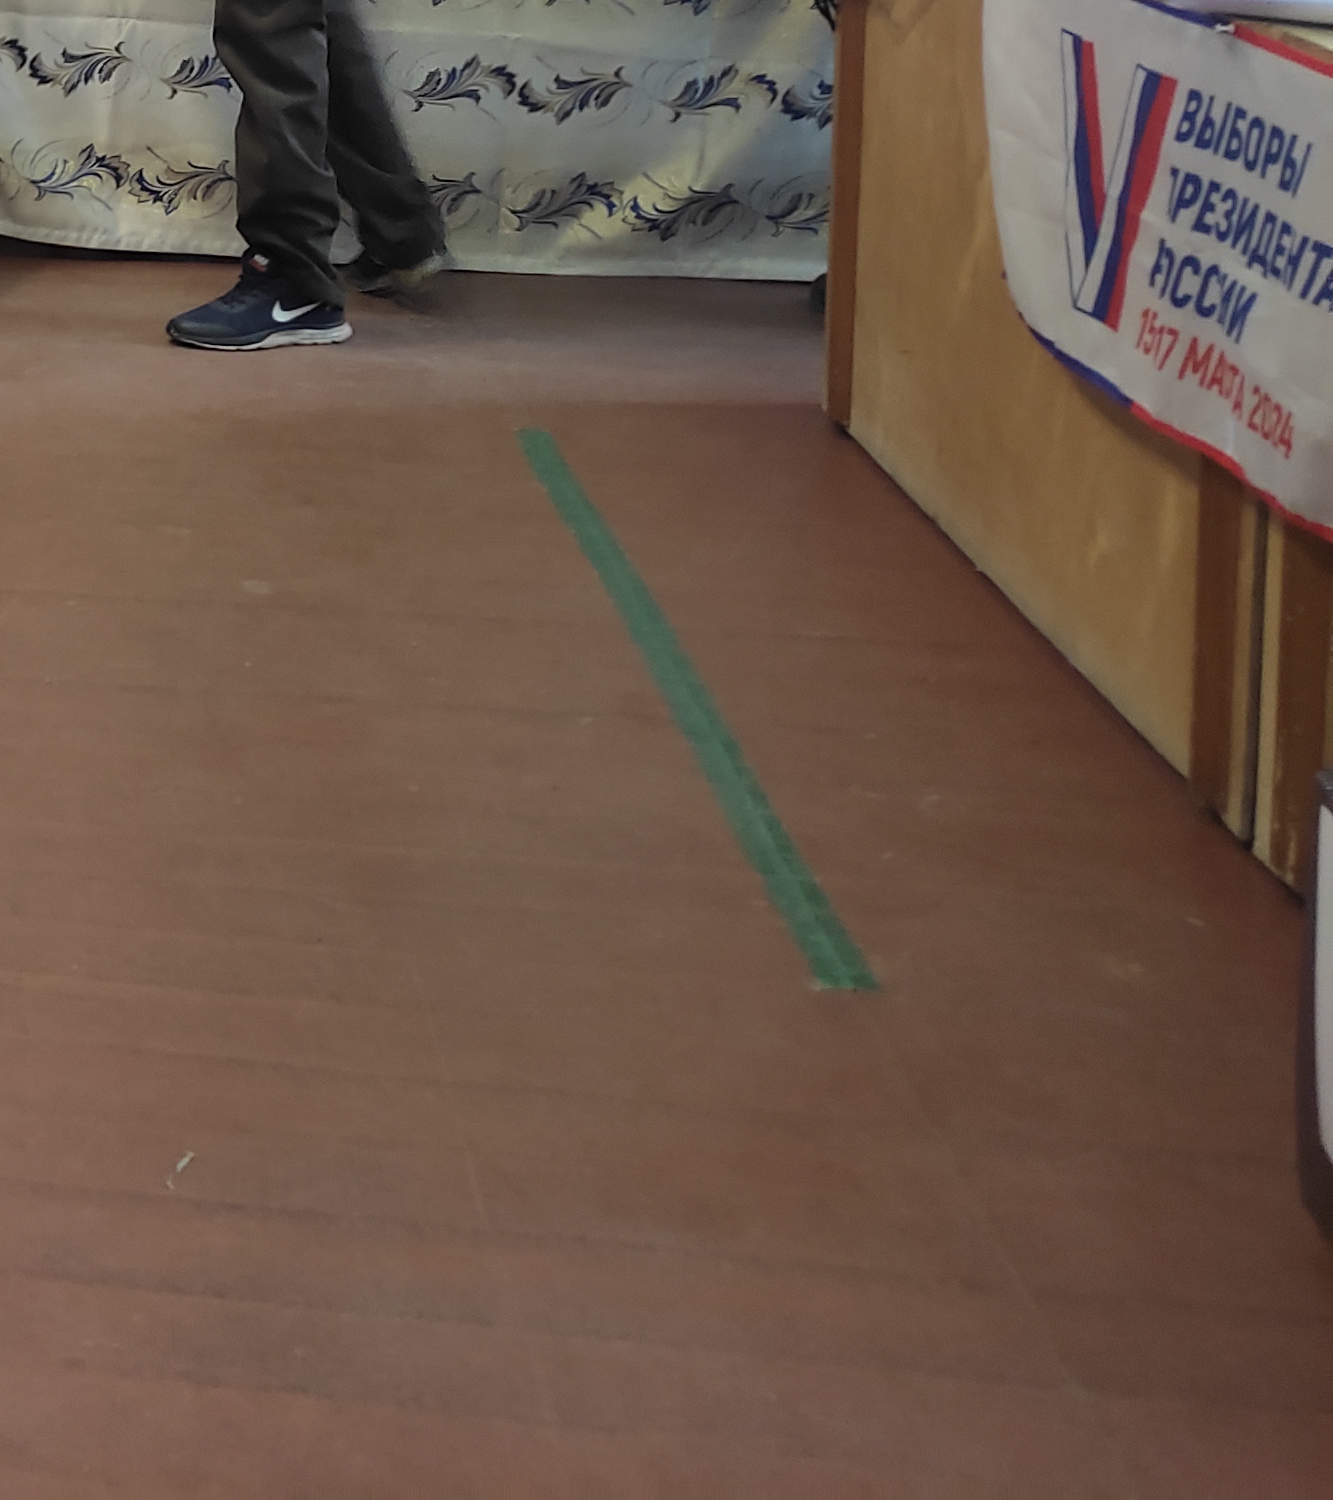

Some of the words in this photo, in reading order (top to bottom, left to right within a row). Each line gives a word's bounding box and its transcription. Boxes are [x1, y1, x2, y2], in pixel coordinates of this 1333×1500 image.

[1174, 88, 1313, 198] ВЫБОРЫ
[1148, 238, 1259, 344] ССИИ
[1136, 307, 1180, 371] 1517
[1177, 336, 1245, 421] МАТА
